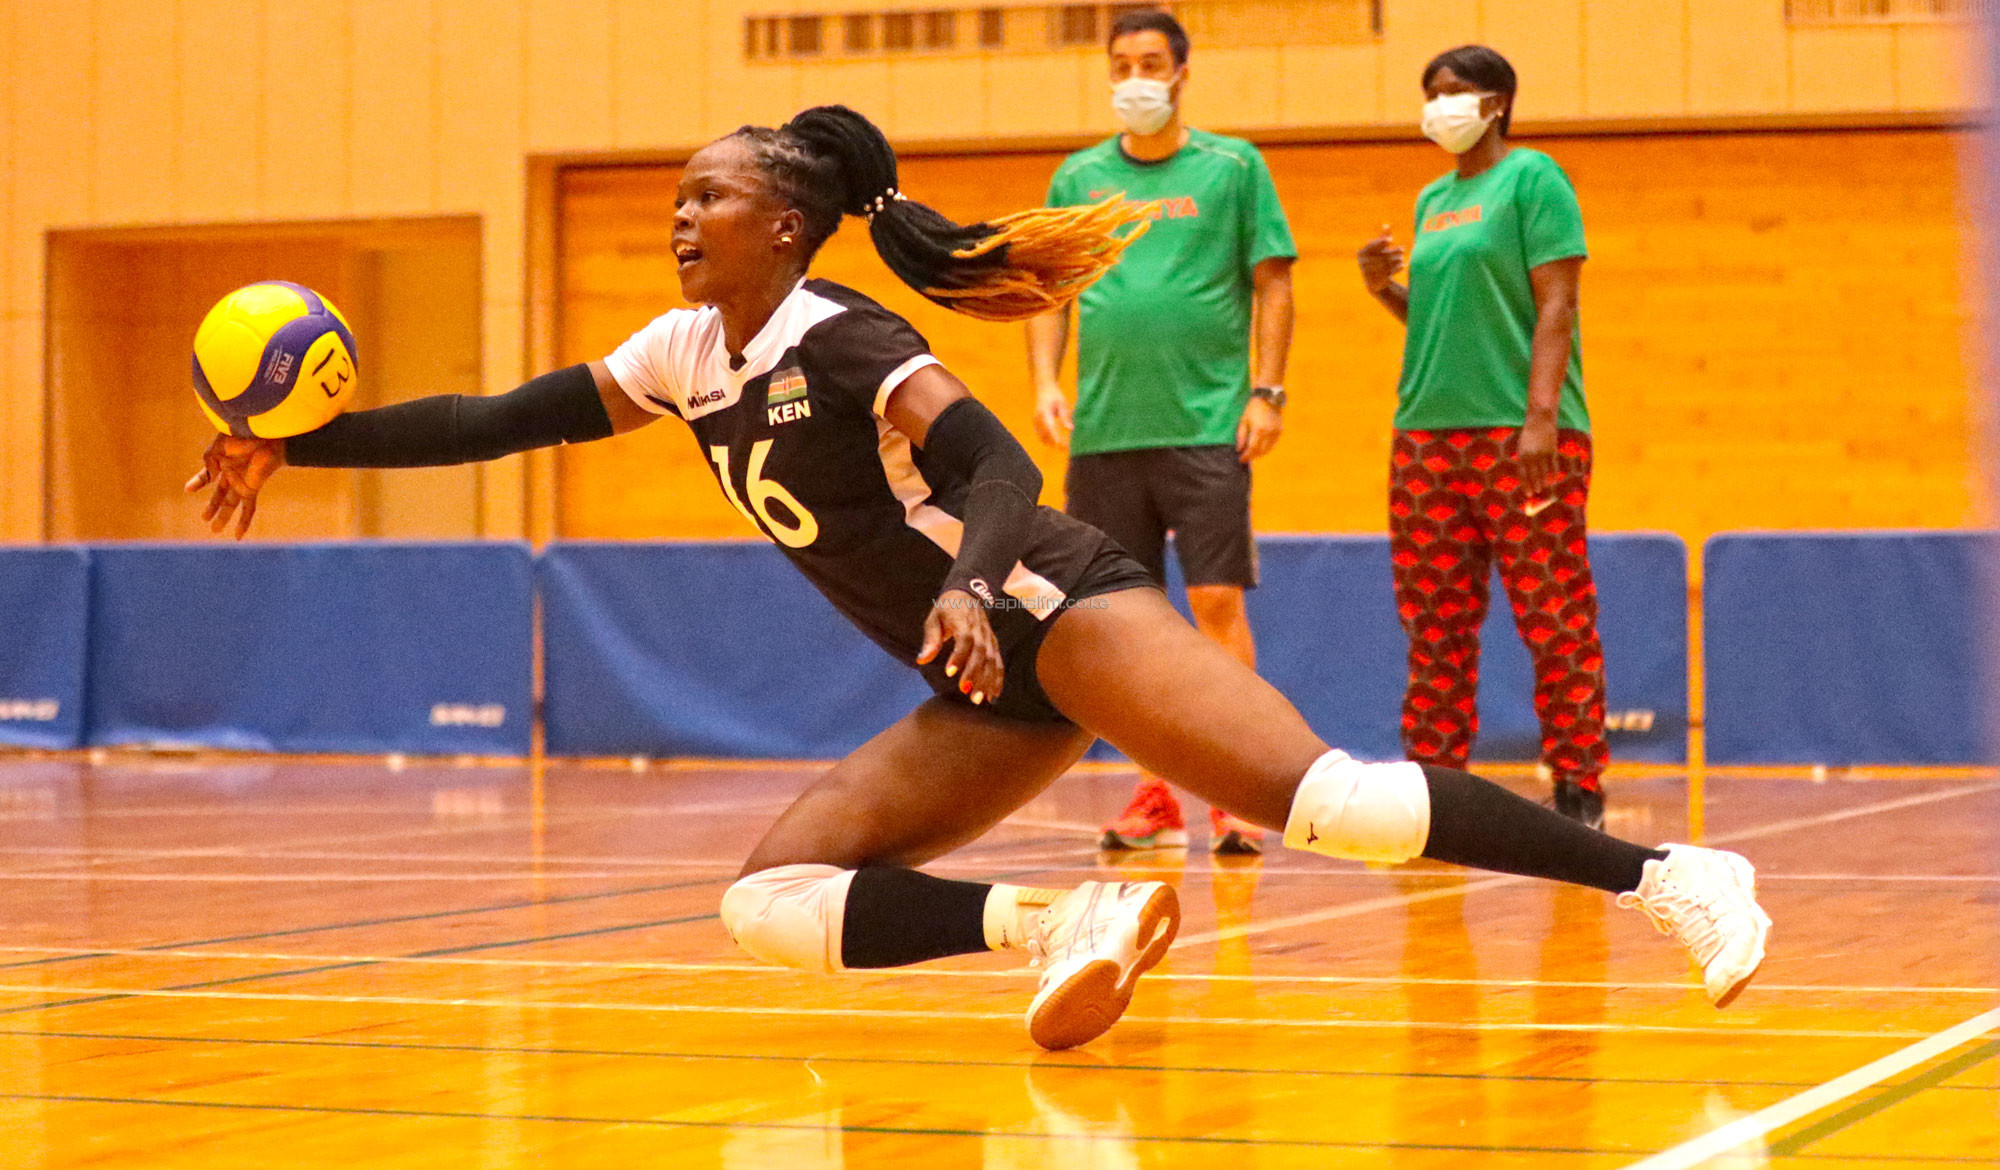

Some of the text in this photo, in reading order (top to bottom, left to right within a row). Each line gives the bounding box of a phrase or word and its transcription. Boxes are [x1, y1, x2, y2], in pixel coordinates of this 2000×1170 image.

[312, 348, 350, 398] 13
[768, 399, 811, 426] KEN
[710, 439, 819, 549] 16
